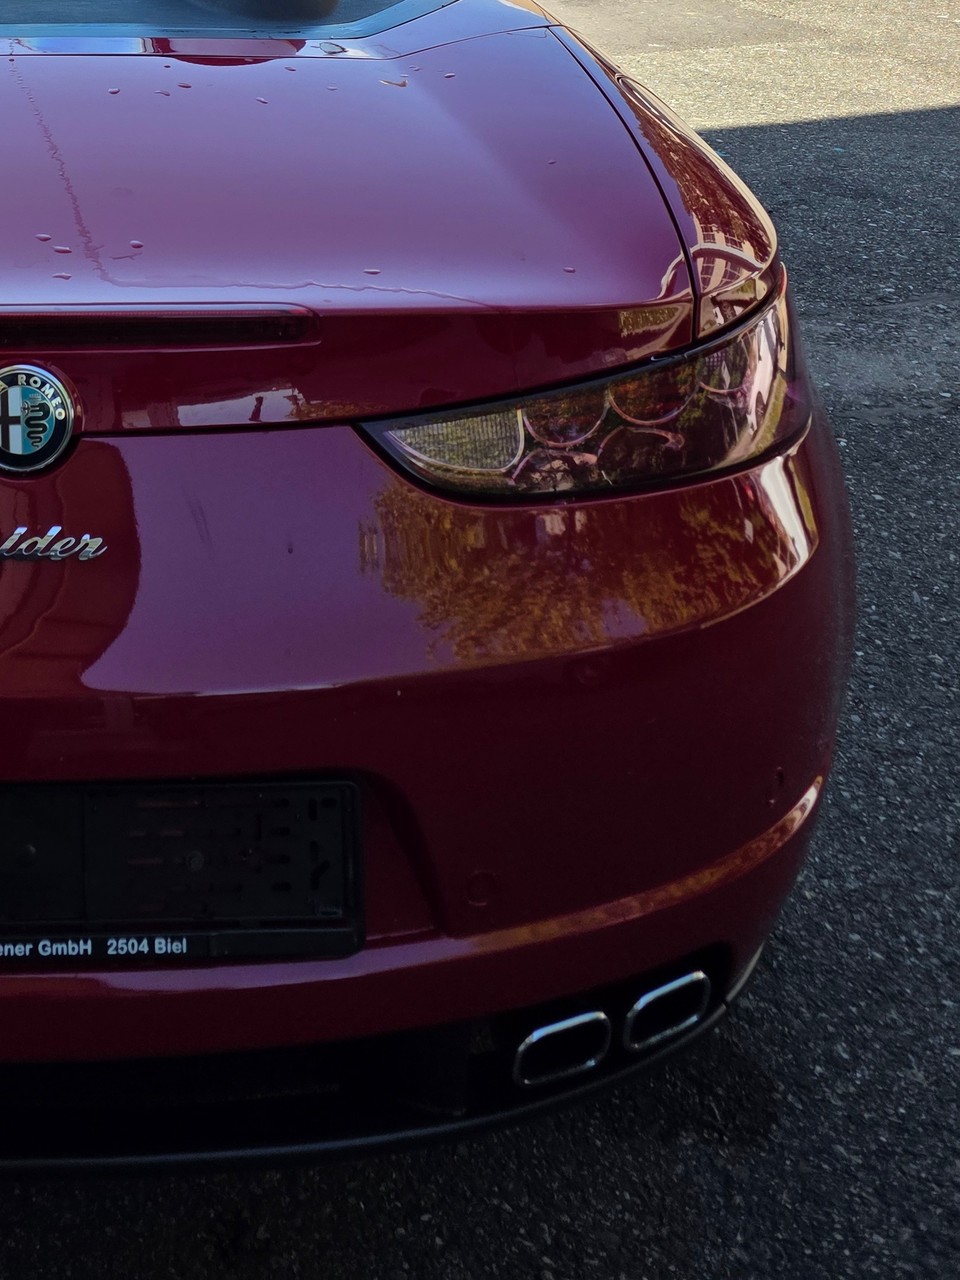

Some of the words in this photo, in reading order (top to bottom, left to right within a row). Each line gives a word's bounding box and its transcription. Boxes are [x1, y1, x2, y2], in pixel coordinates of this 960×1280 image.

[17, 374, 66, 420] ROMEO
[38, 938, 92, 956] GmbH
[107, 937, 149, 955] 2504
[154, 937, 187, 954] Biel
